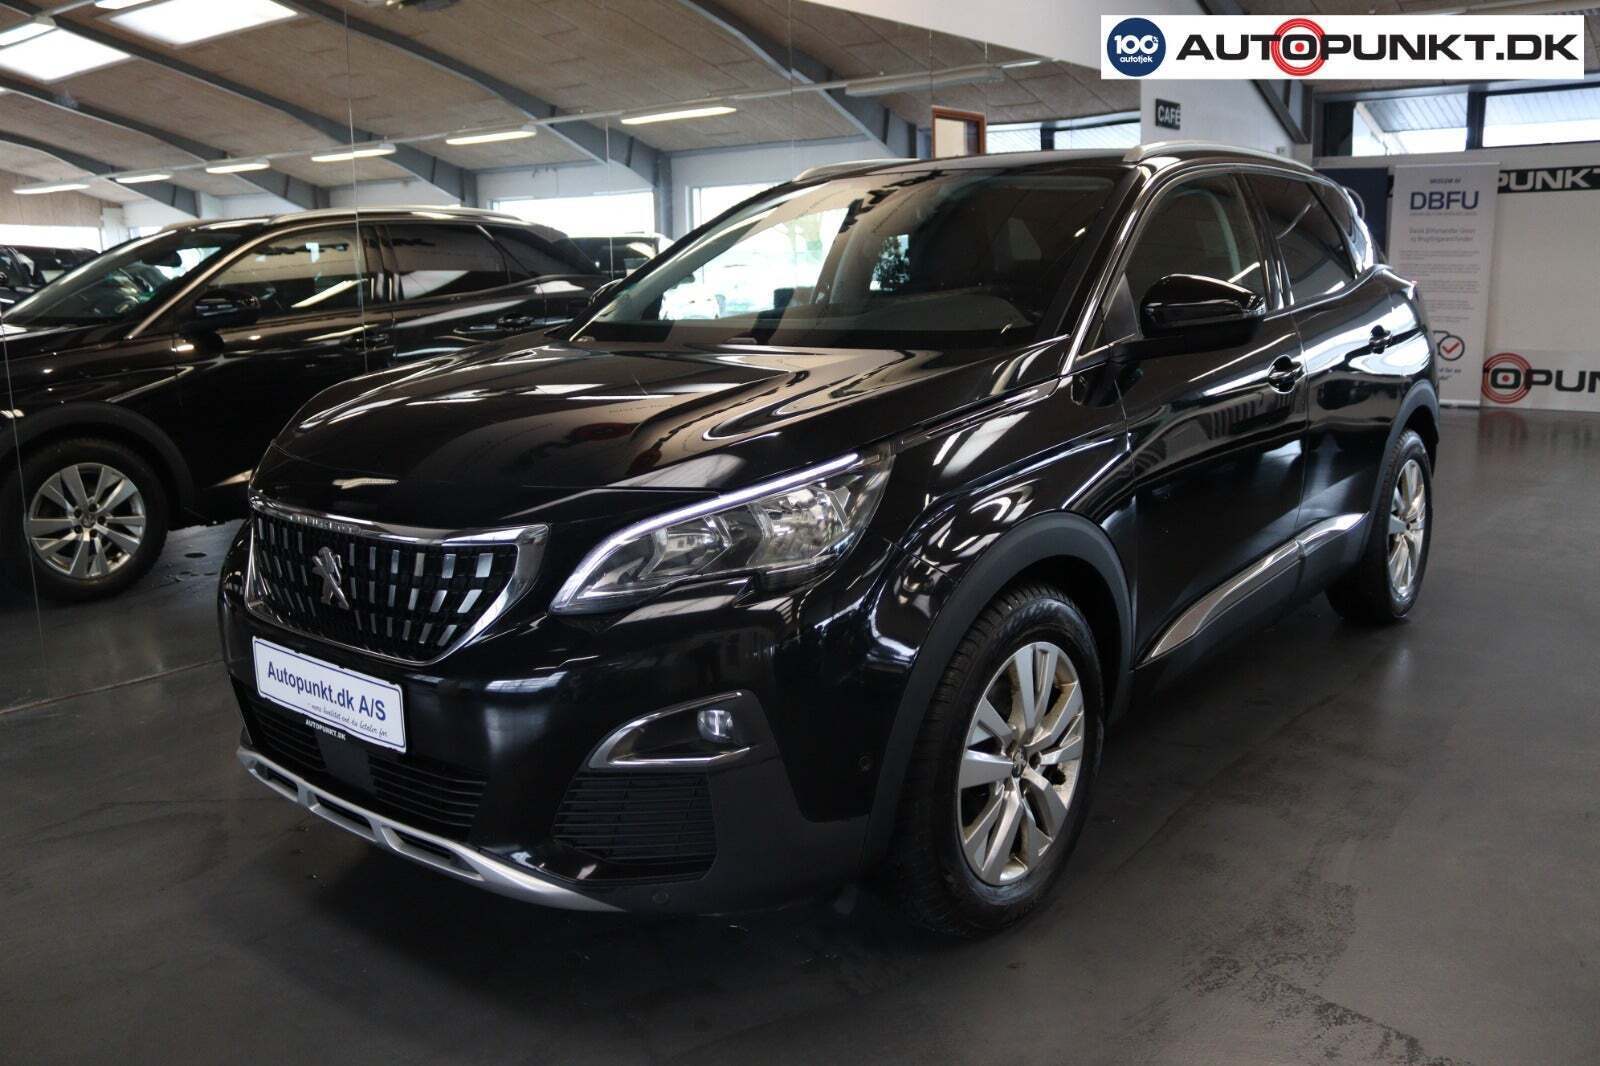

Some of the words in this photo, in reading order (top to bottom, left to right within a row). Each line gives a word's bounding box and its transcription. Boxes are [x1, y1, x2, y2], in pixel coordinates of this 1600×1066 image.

[1410, 191, 1479, 210] DBFU
[1483, 367, 1600, 393] OPU
[268, 661, 354, 711] Autopunkt.dk
[359, 695, 386, 721] A/S
